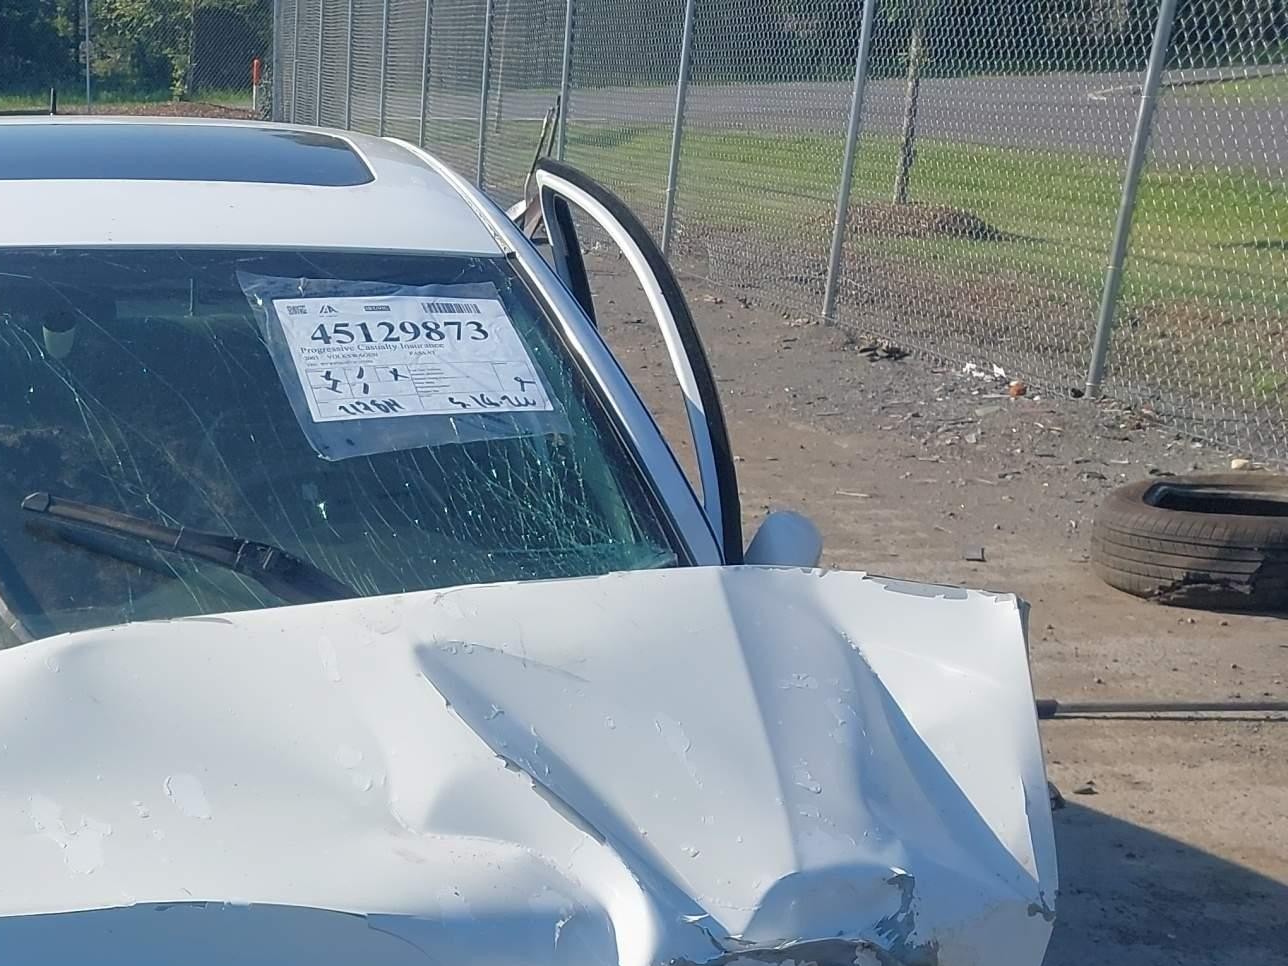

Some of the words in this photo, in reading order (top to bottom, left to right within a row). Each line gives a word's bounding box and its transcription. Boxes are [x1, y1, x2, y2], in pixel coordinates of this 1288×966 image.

[310, 320, 489, 345] 45129873
[300, 344, 354, 354] Progressive
[357, 343, 397, 352] Casualty
[400, 342, 444, 350] Insurance
